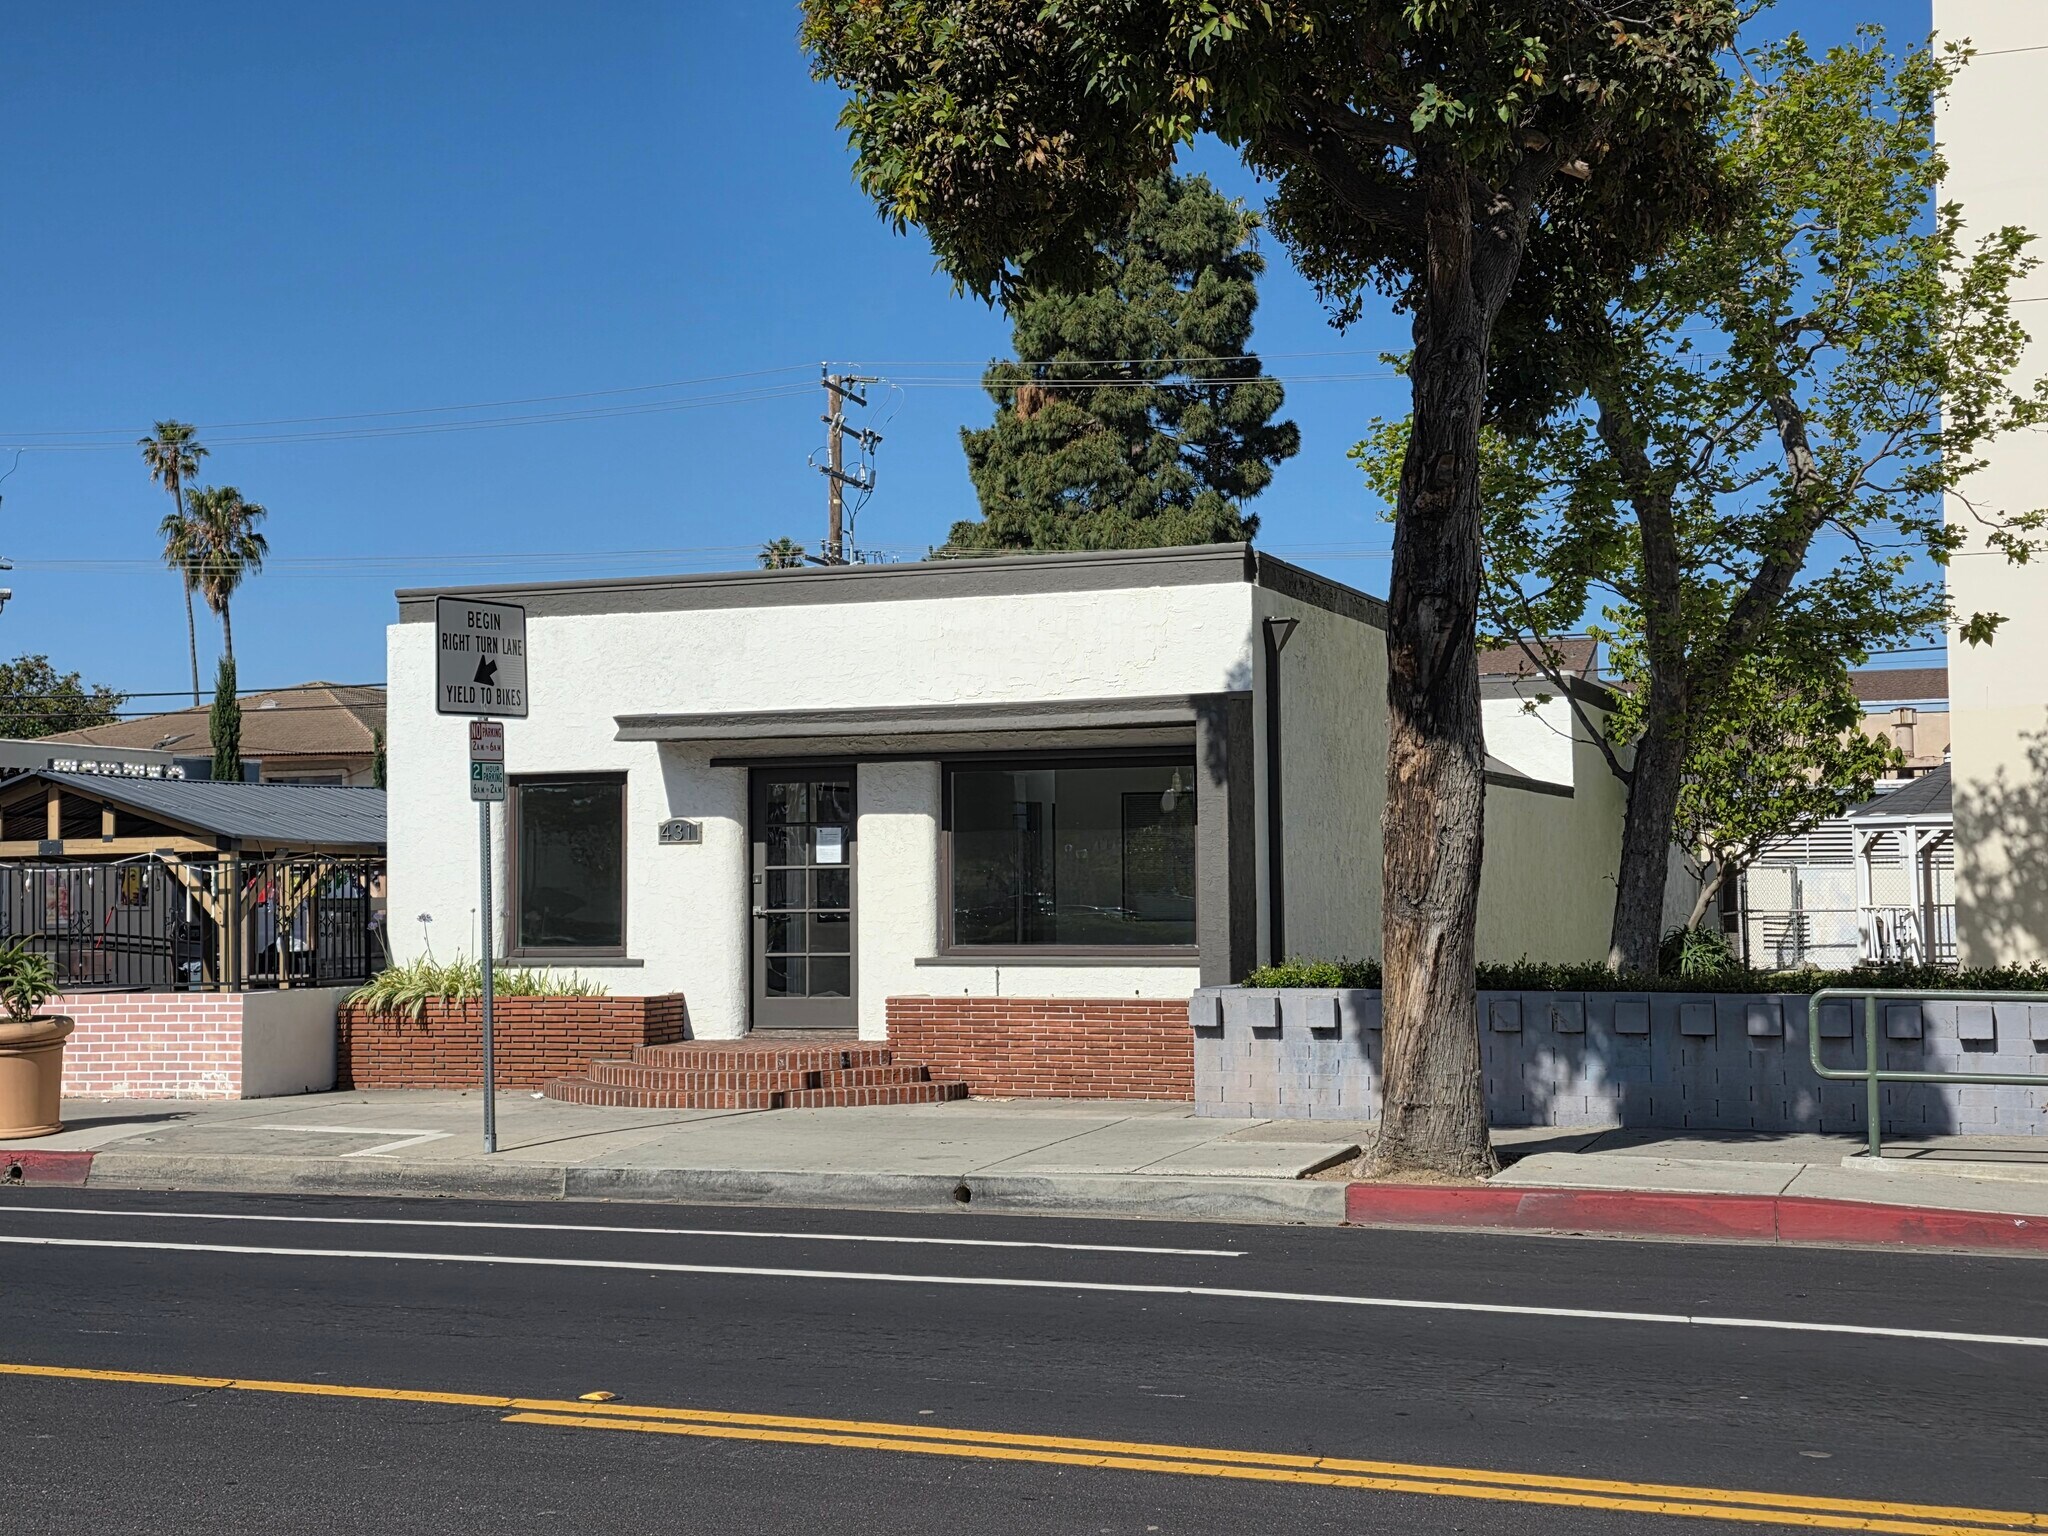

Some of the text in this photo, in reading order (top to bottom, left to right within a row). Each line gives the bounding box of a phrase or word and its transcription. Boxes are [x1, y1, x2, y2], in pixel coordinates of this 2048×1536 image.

[468, 611, 500, 630] BEGIN
[442, 633, 522, 656] RIGHT TURN LANE
[446, 685, 521, 706] YIELD TO BIKES
[472, 722, 501, 739] NO PARKING
[473, 763, 480, 779] 2
[483, 772, 502, 782] PARKING
[486, 765, 499, 773] HOUR
[661, 823, 691, 841] 431
